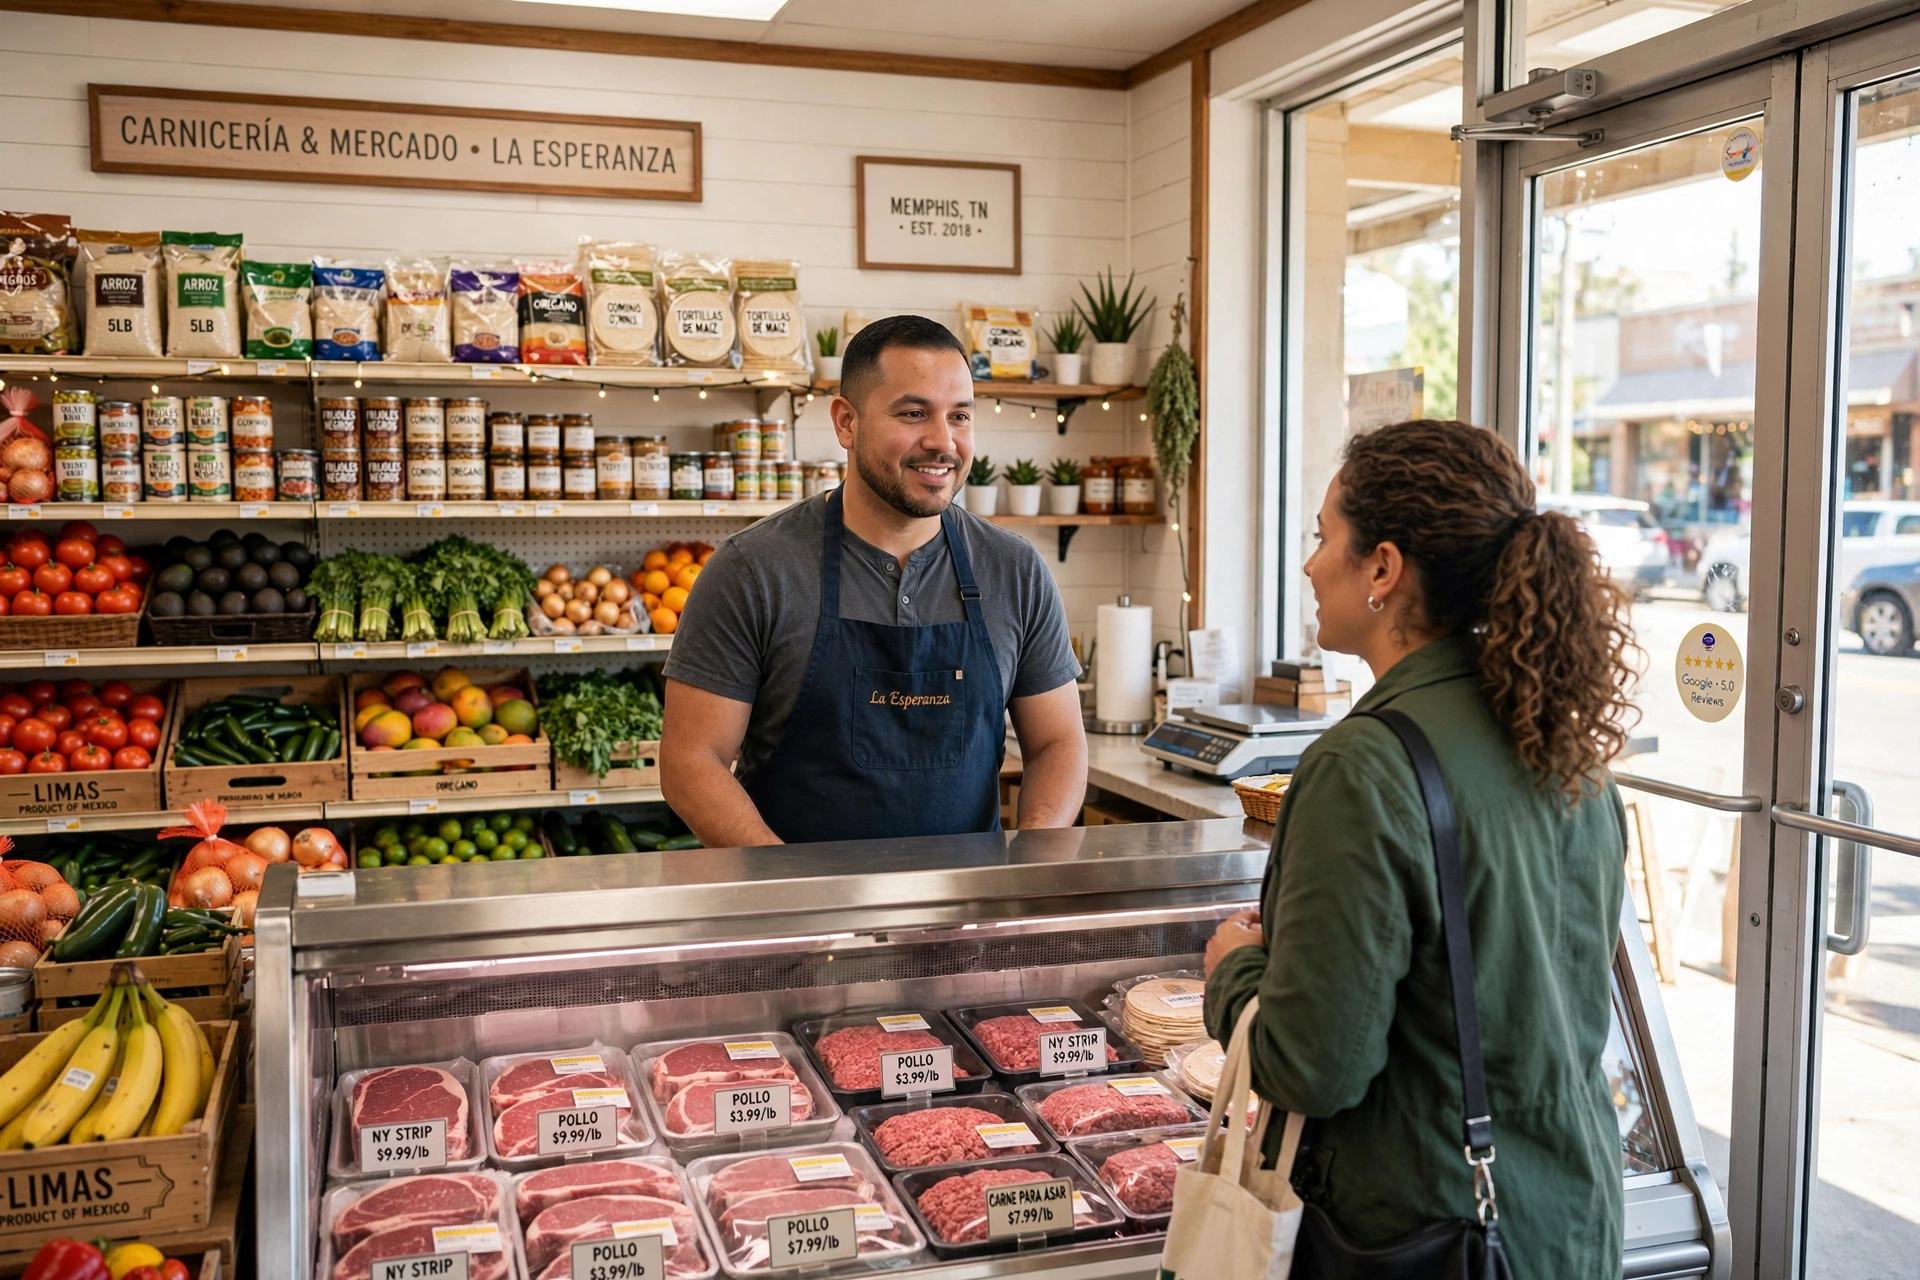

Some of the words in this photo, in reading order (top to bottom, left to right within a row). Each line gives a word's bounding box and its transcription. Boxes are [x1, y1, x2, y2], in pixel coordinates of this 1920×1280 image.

[120, 114, 290, 154] CARNICERÍA
[301, 125, 319, 155] &
[330, 128, 458, 162] MERCADO
[492, 137, 523, 166] LA
[533, 140, 677, 174] ESPERANZA
[890, 196, 964, 220] MEMPHIS,
[968, 200, 988, 219] TN
[911, 220, 937, 236] EST.
[942, 222, 972, 238] 2018
[101, 277, 137, 291] ARROZ
[184, 278, 219, 292] ARROZ
[107, 318, 133, 333] 5LB
[190, 319, 215, 333] 5LB
[1681, 673, 1713, 691] Google
[1720, 680, 1735, 692] 5.0
[869, 690, 887, 705] La
[889, 691, 951, 710] Esperanza
[1690, 691, 1725, 707] Reviews
[34, 781, 100, 802] LIMAS
[19, 803, 63, 814] PRODUCT
[66, 802, 79, 812] OF
[82, 800, 118, 811] MEXICO
[1048, 1036, 1064, 1050] NY
[897, 1053, 934, 1069] POLLO
[1053, 1049, 1094, 1064] $9.99/lb
[895, 1069, 940, 1085] $3.99/lb
[732, 1090, 771, 1106] POLLO
[558, 1111, 599, 1127] POLLO
[730, 1106, 777, 1123] $3.99/lb
[372, 1128, 390, 1144] NY
[395, 1125, 433, 1142] STRIP
[552, 1127, 602, 1145] $9.99/lb
[377, 1145, 430, 1162] $9.99/lb
[8, 1168, 114, 1209] LIMAS
[989, 1191, 1017, 1207] CARNE
[1019, 1189, 1043, 1204] PARA
[1044, 1185, 1067, 1201] ASAR
[0, 1210, 57, 1228] PRODUCT
[62, 1208, 77, 1220] OF
[82, 1202, 130, 1218] MEXICO
[1008, 1206, 1054, 1226] $7.99/lb
[788, 1216, 829, 1235] POLLO
[593, 1242, 637, 1262] POLLO
[788, 1234, 840, 1255] $7.99/lb
[386, 1264, 406, 1280] NY
[411, 1258, 453, 1279] STRIP
[590, 1263, 645, 1280] $3.99/lb
